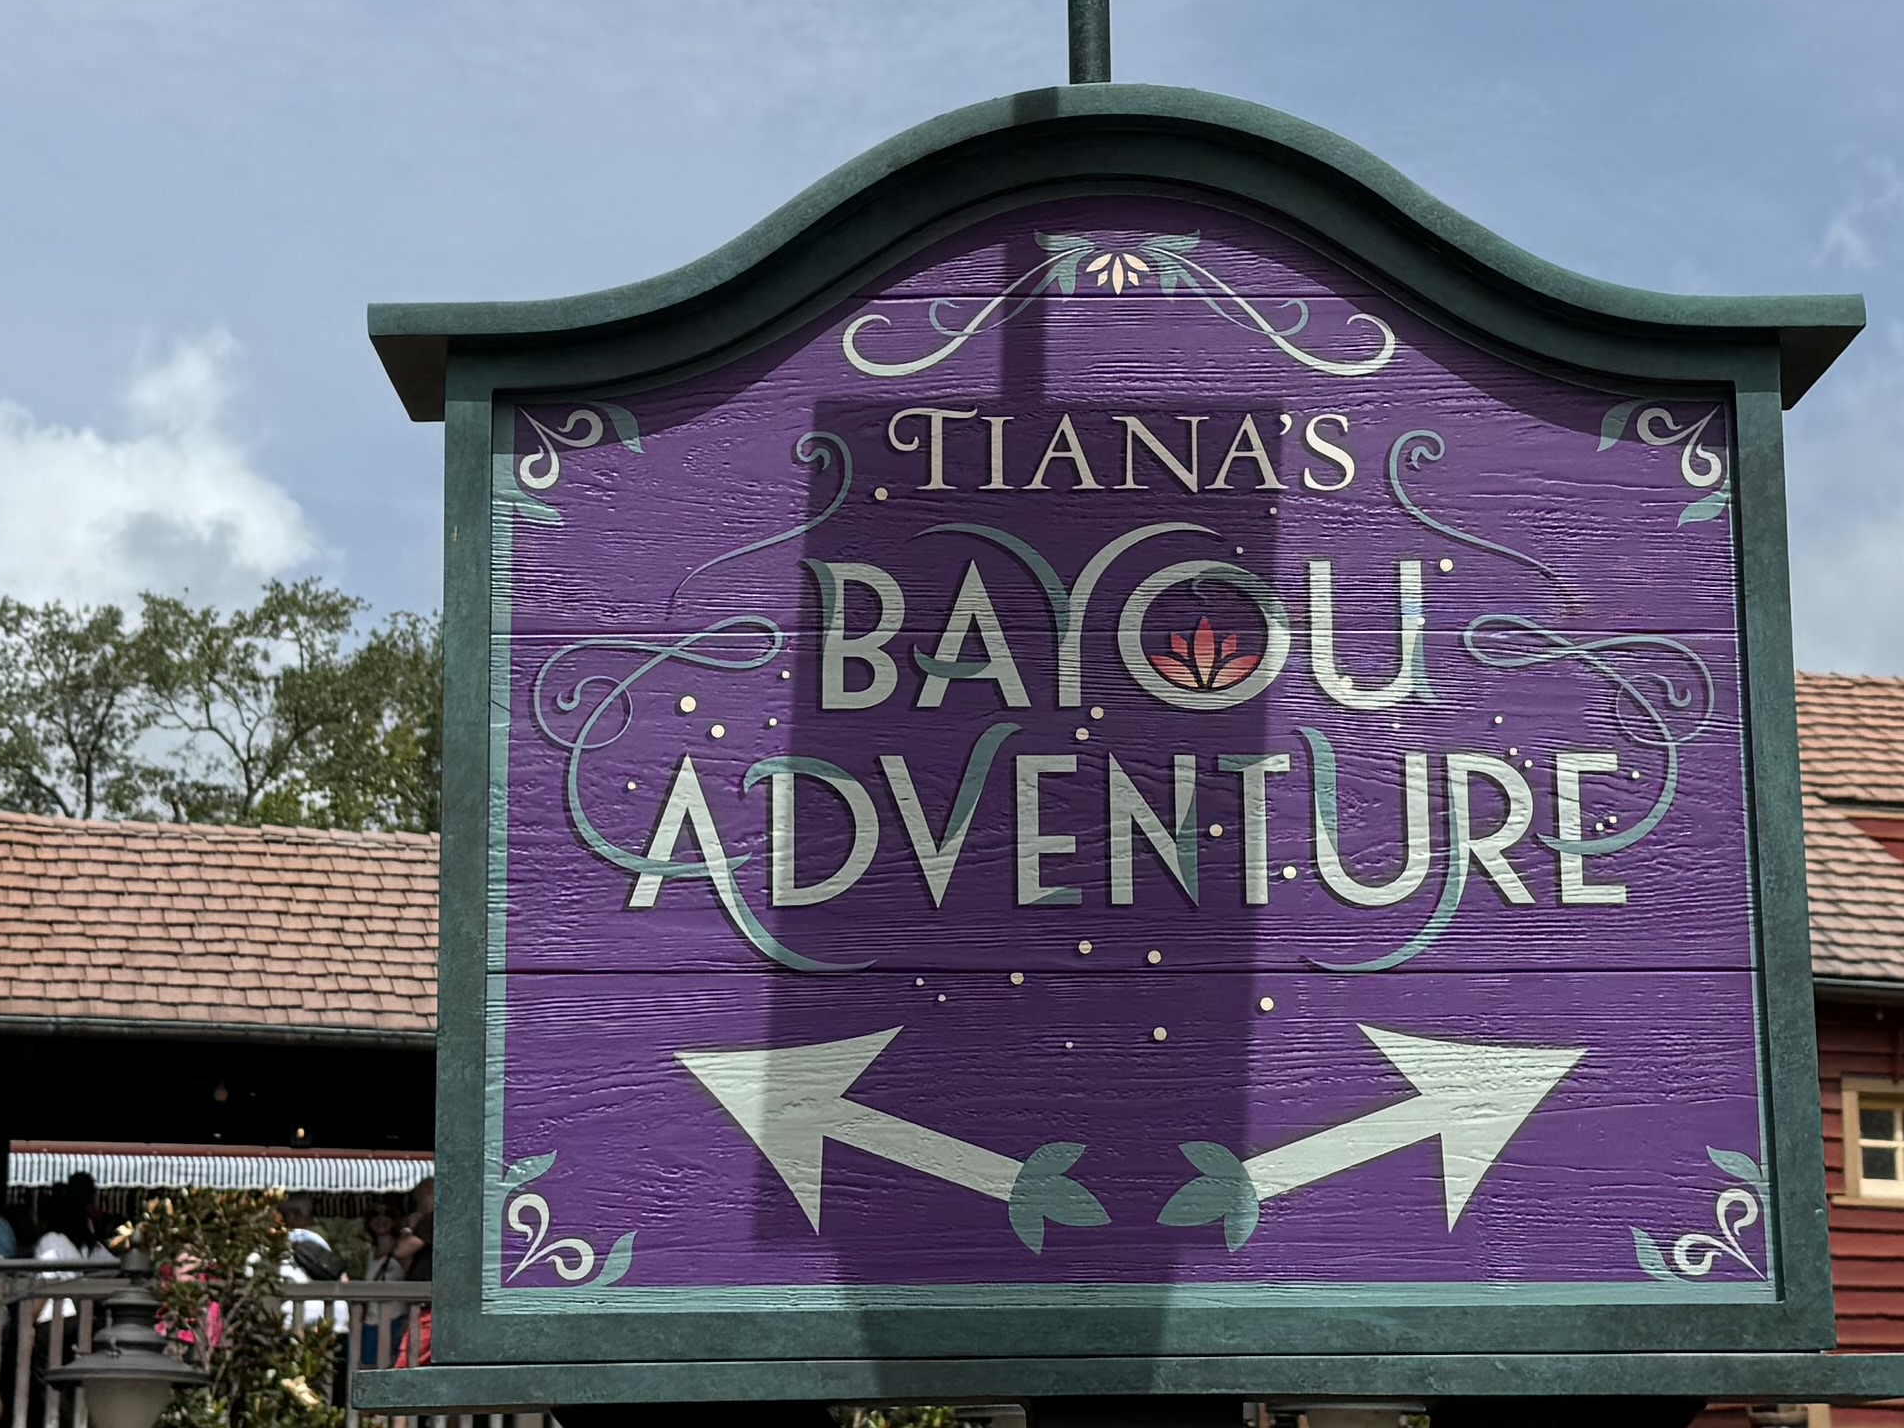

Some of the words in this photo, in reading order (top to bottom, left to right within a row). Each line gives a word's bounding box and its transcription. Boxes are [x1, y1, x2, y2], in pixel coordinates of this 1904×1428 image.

[888, 405, 1358, 493] TIANA'S
[804, 521, 1438, 712] BAYOU
[627, 725, 1632, 970] ADVENTURE
